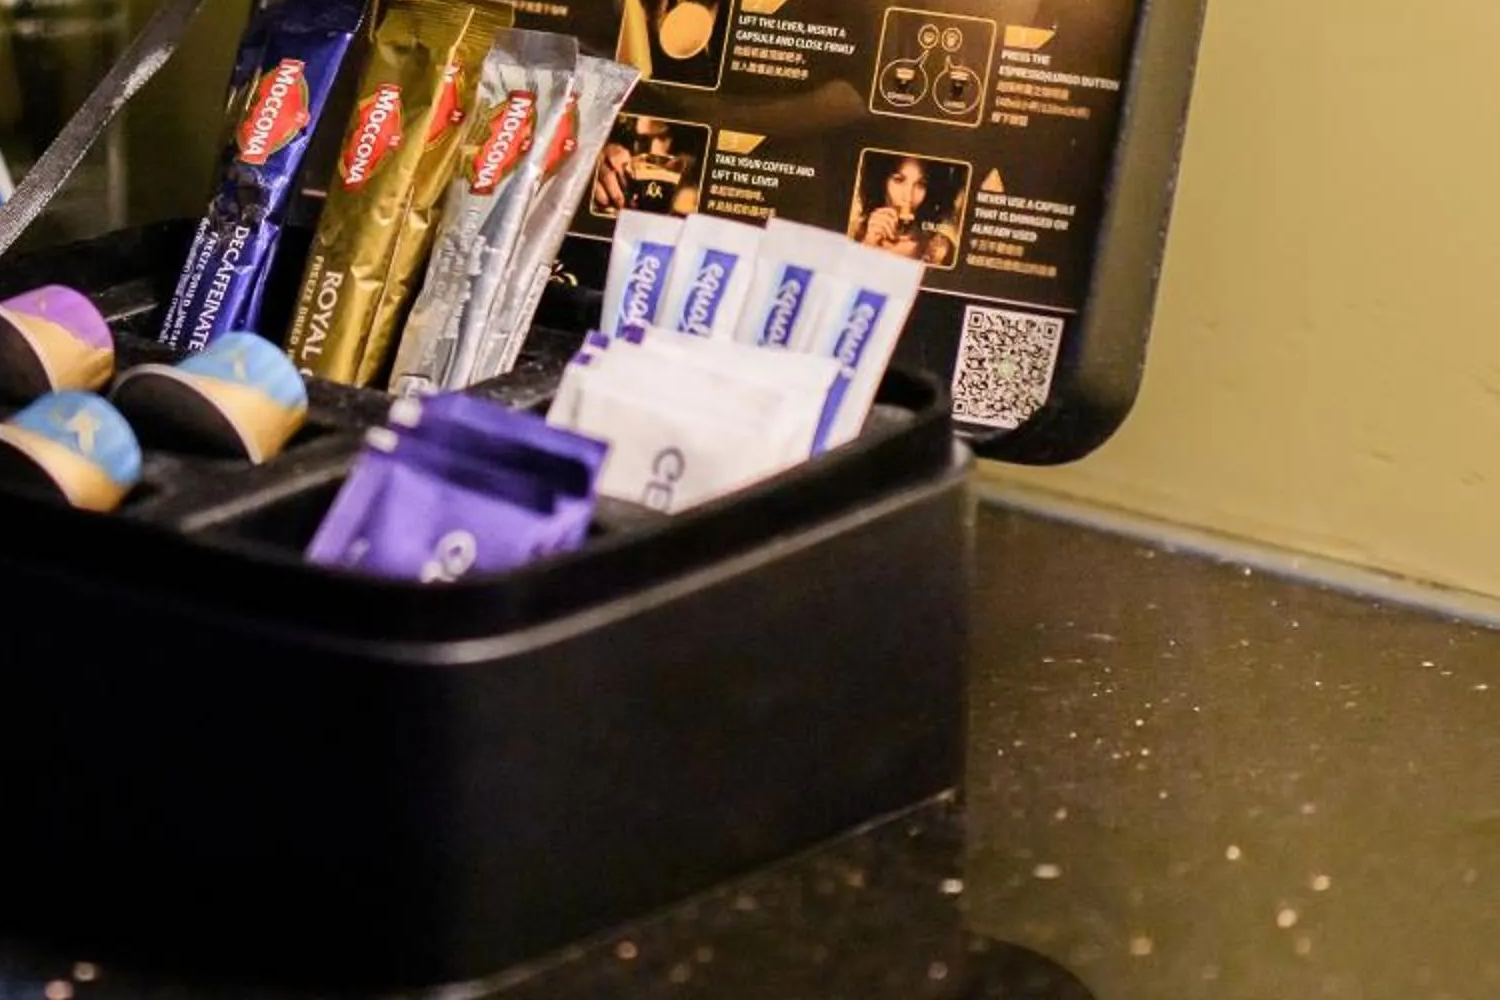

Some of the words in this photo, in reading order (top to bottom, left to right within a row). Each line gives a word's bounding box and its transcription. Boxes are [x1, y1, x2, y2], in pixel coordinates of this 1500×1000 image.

[243, 64, 300, 157] MOCCONA
[345, 89, 400, 185] MOCCONA
[473, 96, 533, 190] MOCCONA
[187, 225, 250, 352] DECAFFEINATE
[301, 271, 344, 360] ROYAL
